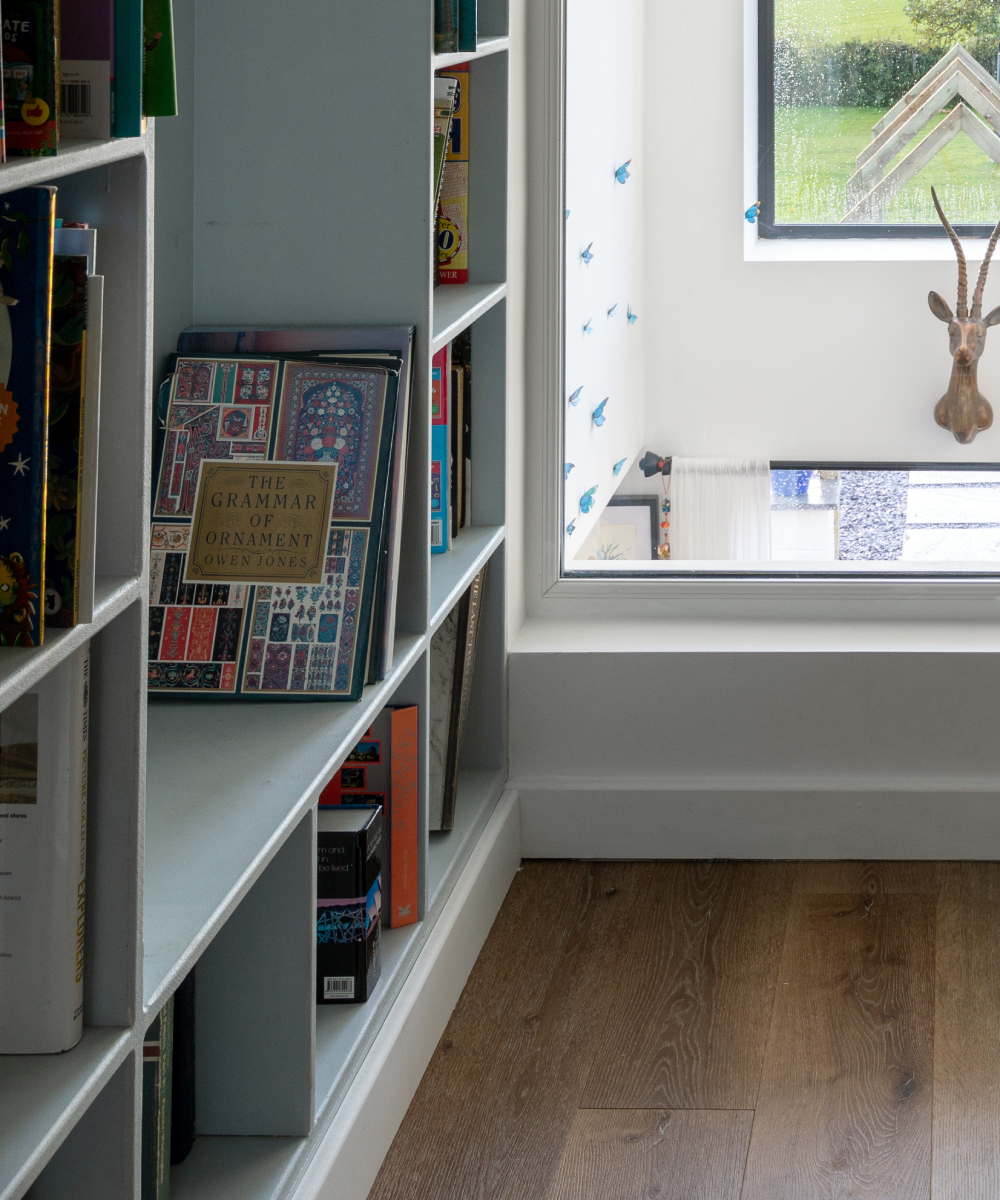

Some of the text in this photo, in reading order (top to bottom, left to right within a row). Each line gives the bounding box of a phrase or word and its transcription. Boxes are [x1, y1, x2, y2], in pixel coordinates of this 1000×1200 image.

[248, 475, 286, 490] THE
[210, 491, 316, 510] GRAMMAR
[249, 513, 274, 528] OF
[205, 530, 313, 548] ORNAMENT
[204, 553, 307, 568] OWEN JONES
[469, 601, 479, 636] LAST
[465, 639, 473, 675] TWO
[328, 846, 345, 854] and
[322, 855, 329, 863] in
[319, 864, 330, 872] be
[75, 878, 87, 984] EXPLORERS
